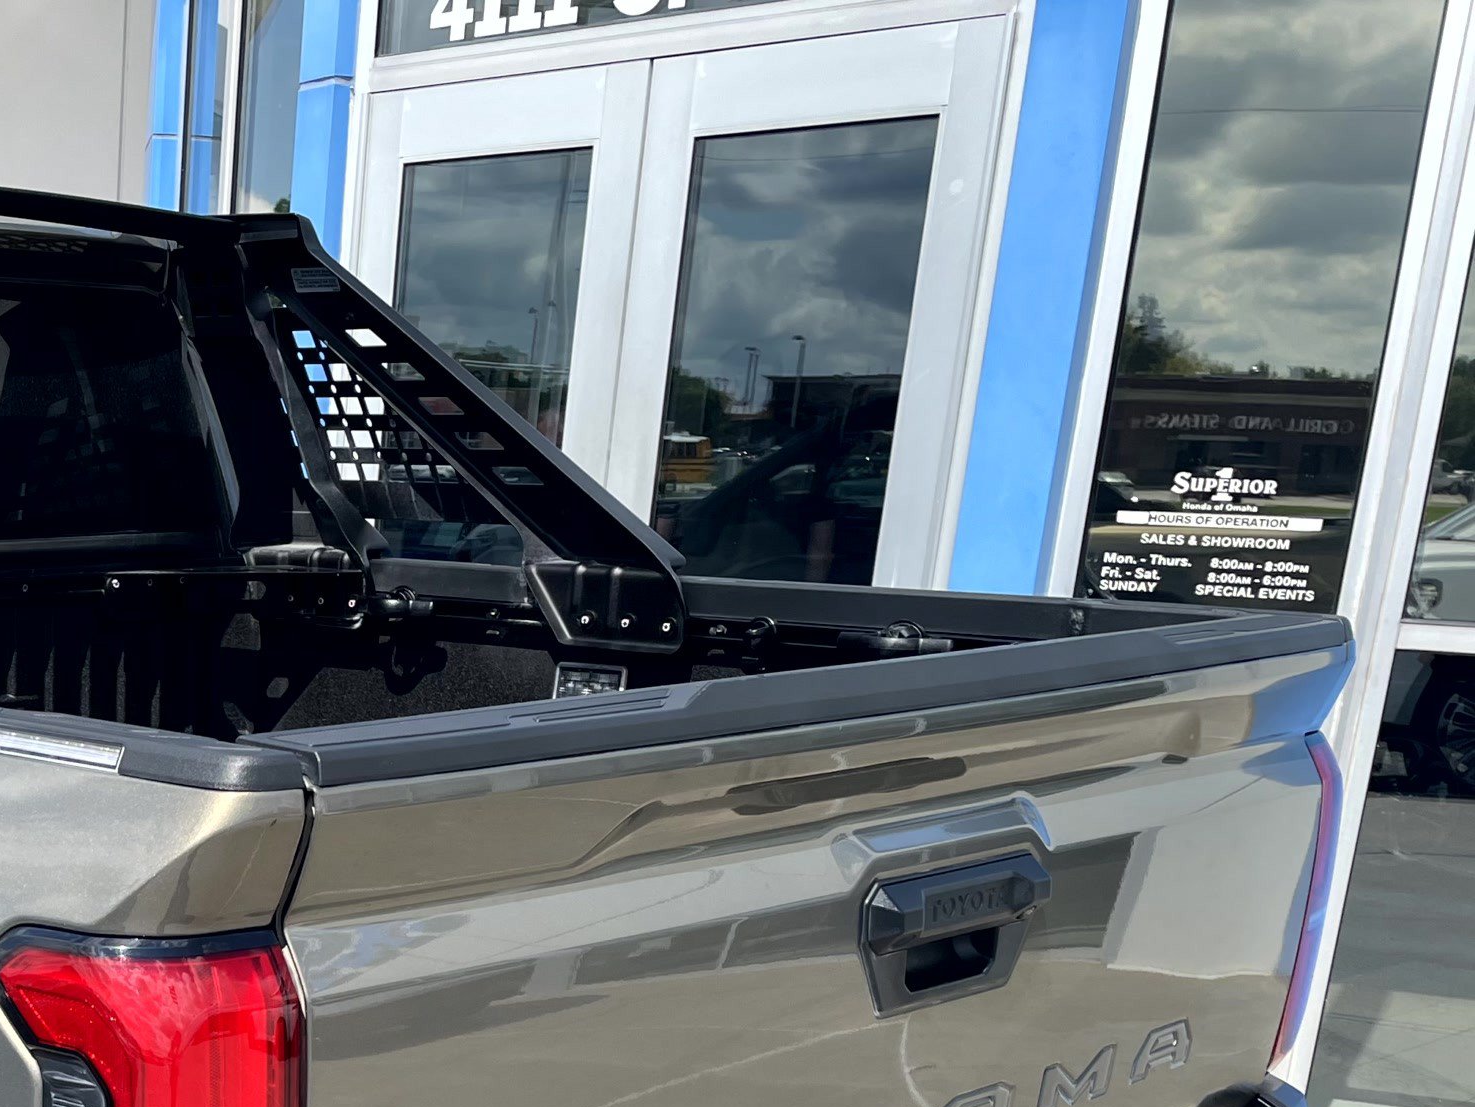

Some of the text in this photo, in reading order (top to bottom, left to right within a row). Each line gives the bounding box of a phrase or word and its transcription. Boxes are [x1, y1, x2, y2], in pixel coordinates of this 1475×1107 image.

[1182, 502, 1258, 512] Honda of Omaha
[1148, 514, 1289, 528] HOURS OF OPERATION
[1140, 533, 1290, 550] SALES & SHOWROOM
[1103, 552, 1137, 565] Mon.
[1149, 553, 1192, 567] Thurs.
[1100, 566, 1122, 579] Fri.
[1134, 567, 1161, 580] Sat.
[1099, 579, 1315, 602] SUNDAY SPECIAL EVENTS
